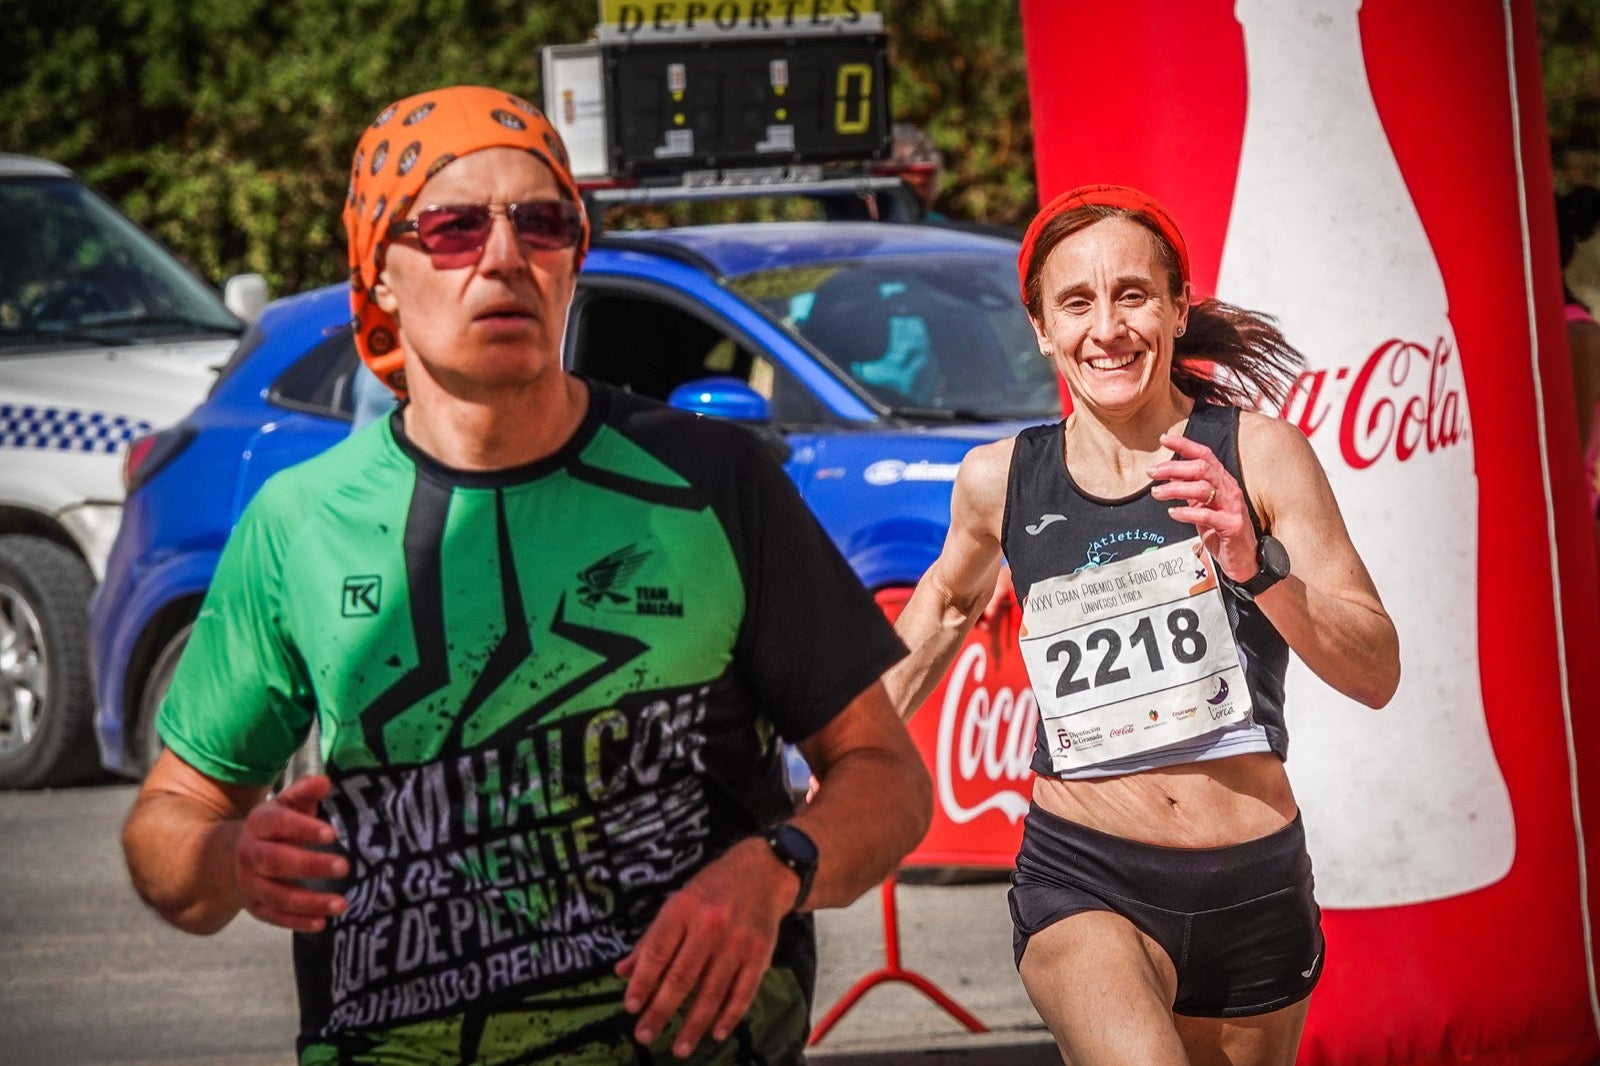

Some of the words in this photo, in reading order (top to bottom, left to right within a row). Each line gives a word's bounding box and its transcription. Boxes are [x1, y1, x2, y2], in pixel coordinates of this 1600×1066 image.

[617, 0, 862, 34] DEPORTES
[1278, 336, 1468, 469] a-Cola
[1093, 529, 1165, 551] Atletismo
[1028, 593, 1054, 613] XXXV
[1159, 556, 1186, 578] 2022
[1046, 607, 1208, 699] 2218
[1079, 733, 1103, 745] Granada
[330, 914, 394, 1004] QUE
[396, 900, 449, 974] DE
[448, 864, 615, 958] PIERNAS
